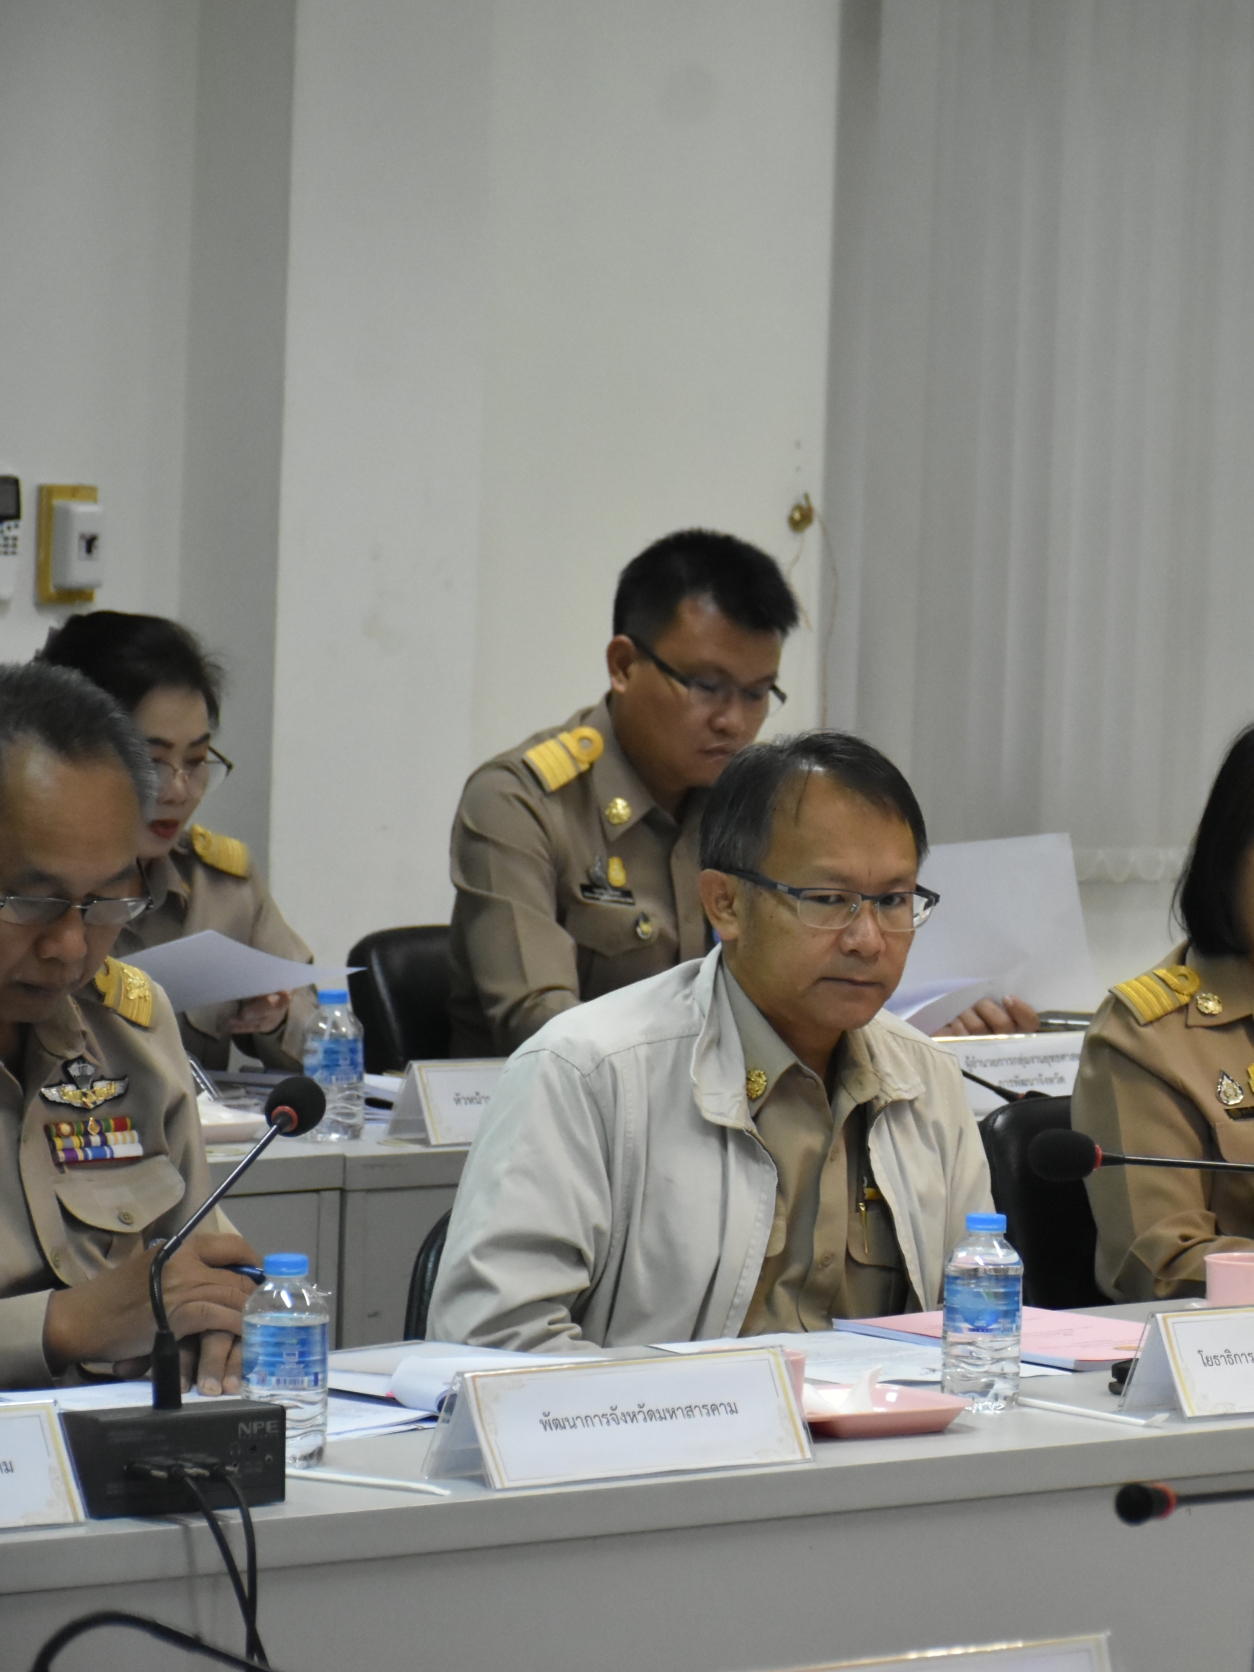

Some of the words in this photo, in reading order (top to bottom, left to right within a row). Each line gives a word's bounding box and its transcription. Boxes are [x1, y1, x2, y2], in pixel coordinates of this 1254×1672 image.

[238, 1419, 280, 1436] NPE
[539, 1401, 739, 1432] พัฒนาการจังหวัดมหาสารคาม
